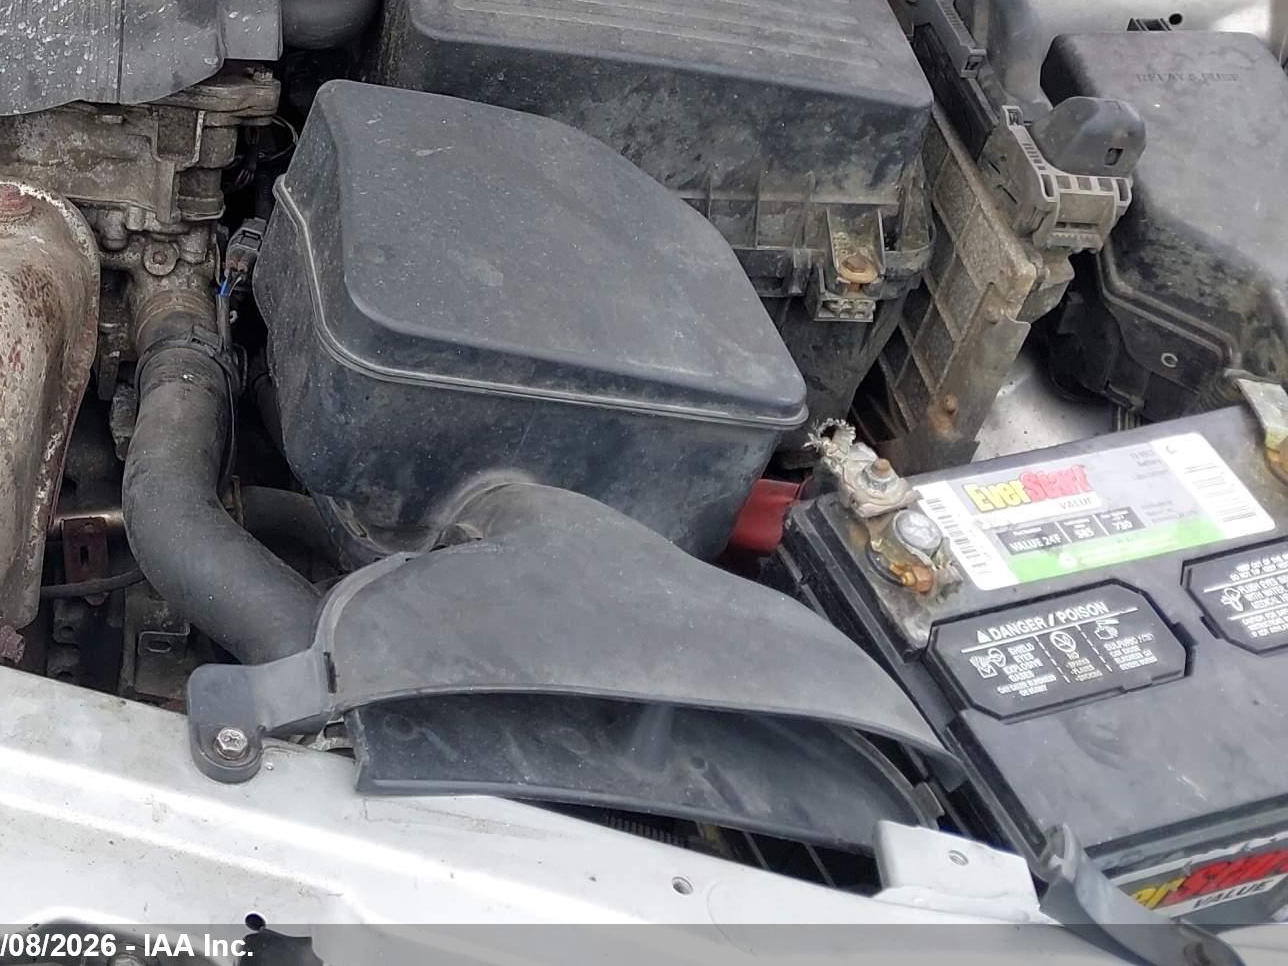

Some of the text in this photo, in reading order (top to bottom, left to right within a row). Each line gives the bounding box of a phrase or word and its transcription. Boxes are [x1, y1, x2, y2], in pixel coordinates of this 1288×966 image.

[963, 464, 1093, 514] EverStart
[1060, 497, 1094, 511] VALUE
[1008, 537, 1044, 553] VALUE
[988, 616, 1048, 641] DANGER
[1055, 601, 1110, 624] POISON
